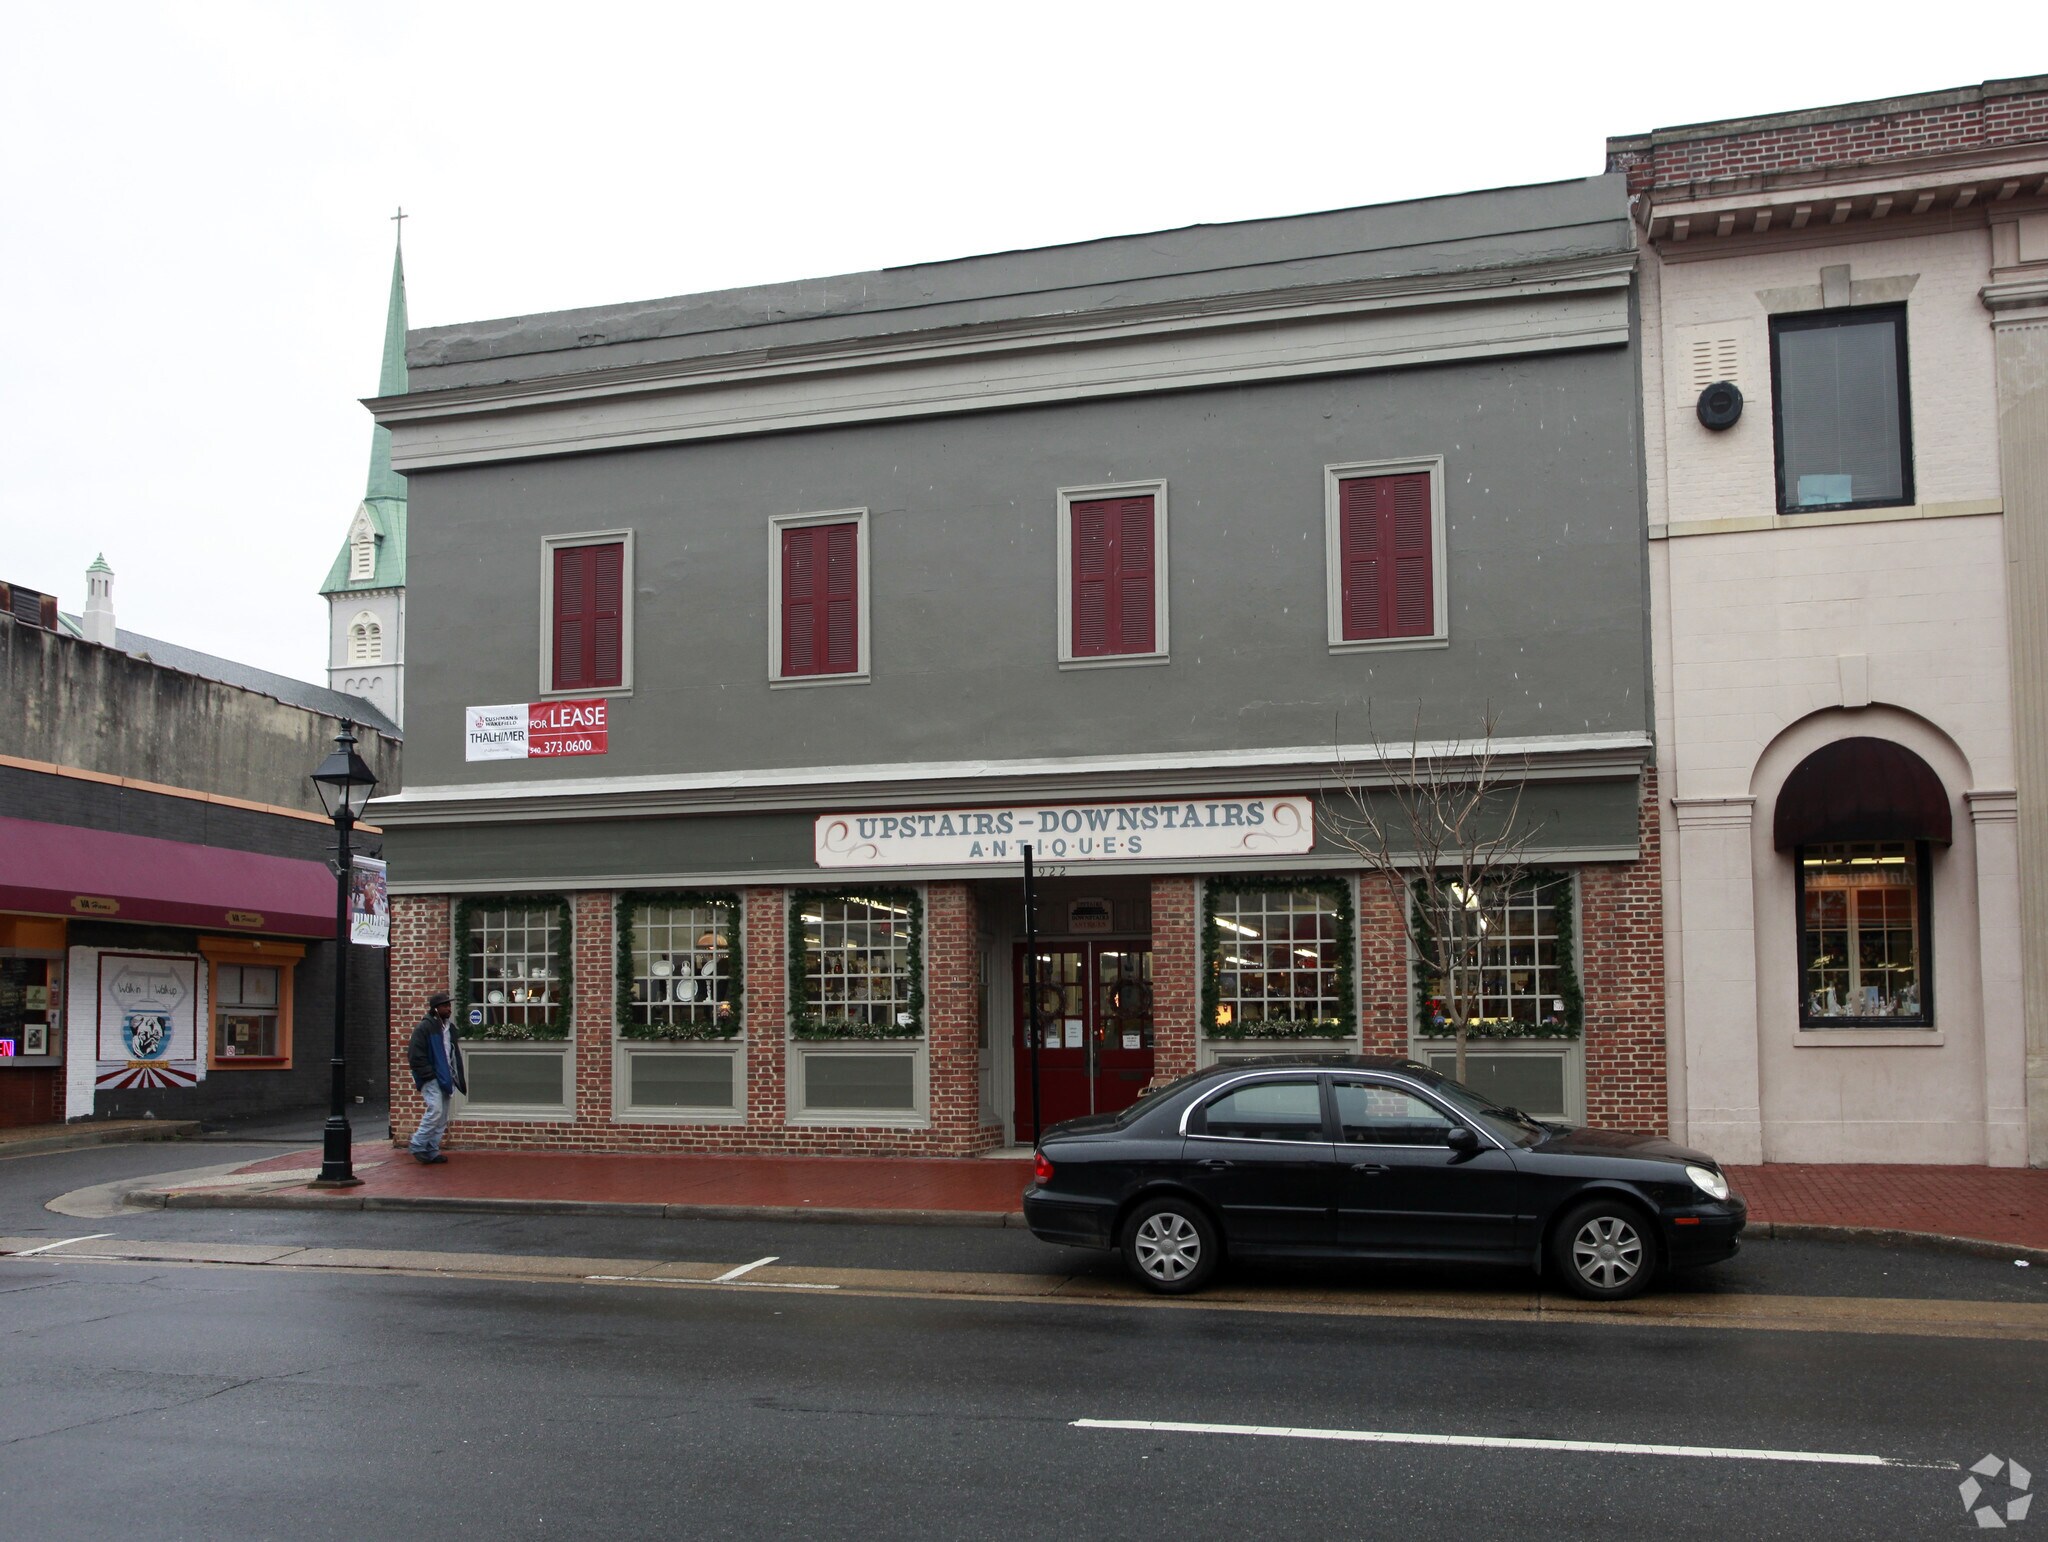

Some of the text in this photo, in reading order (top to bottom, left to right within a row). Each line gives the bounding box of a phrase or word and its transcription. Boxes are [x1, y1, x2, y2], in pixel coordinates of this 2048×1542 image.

[530, 707, 605, 729] FOR LEASE
[470, 731, 525, 743] THALHIMER
[544, 740, 592, 753] 373.0600
[1038, 866, 1066, 877] 922
[80, 899, 90, 908] VA
[232, 913, 240, 922] VA
[353, 912, 385, 928] DINING
